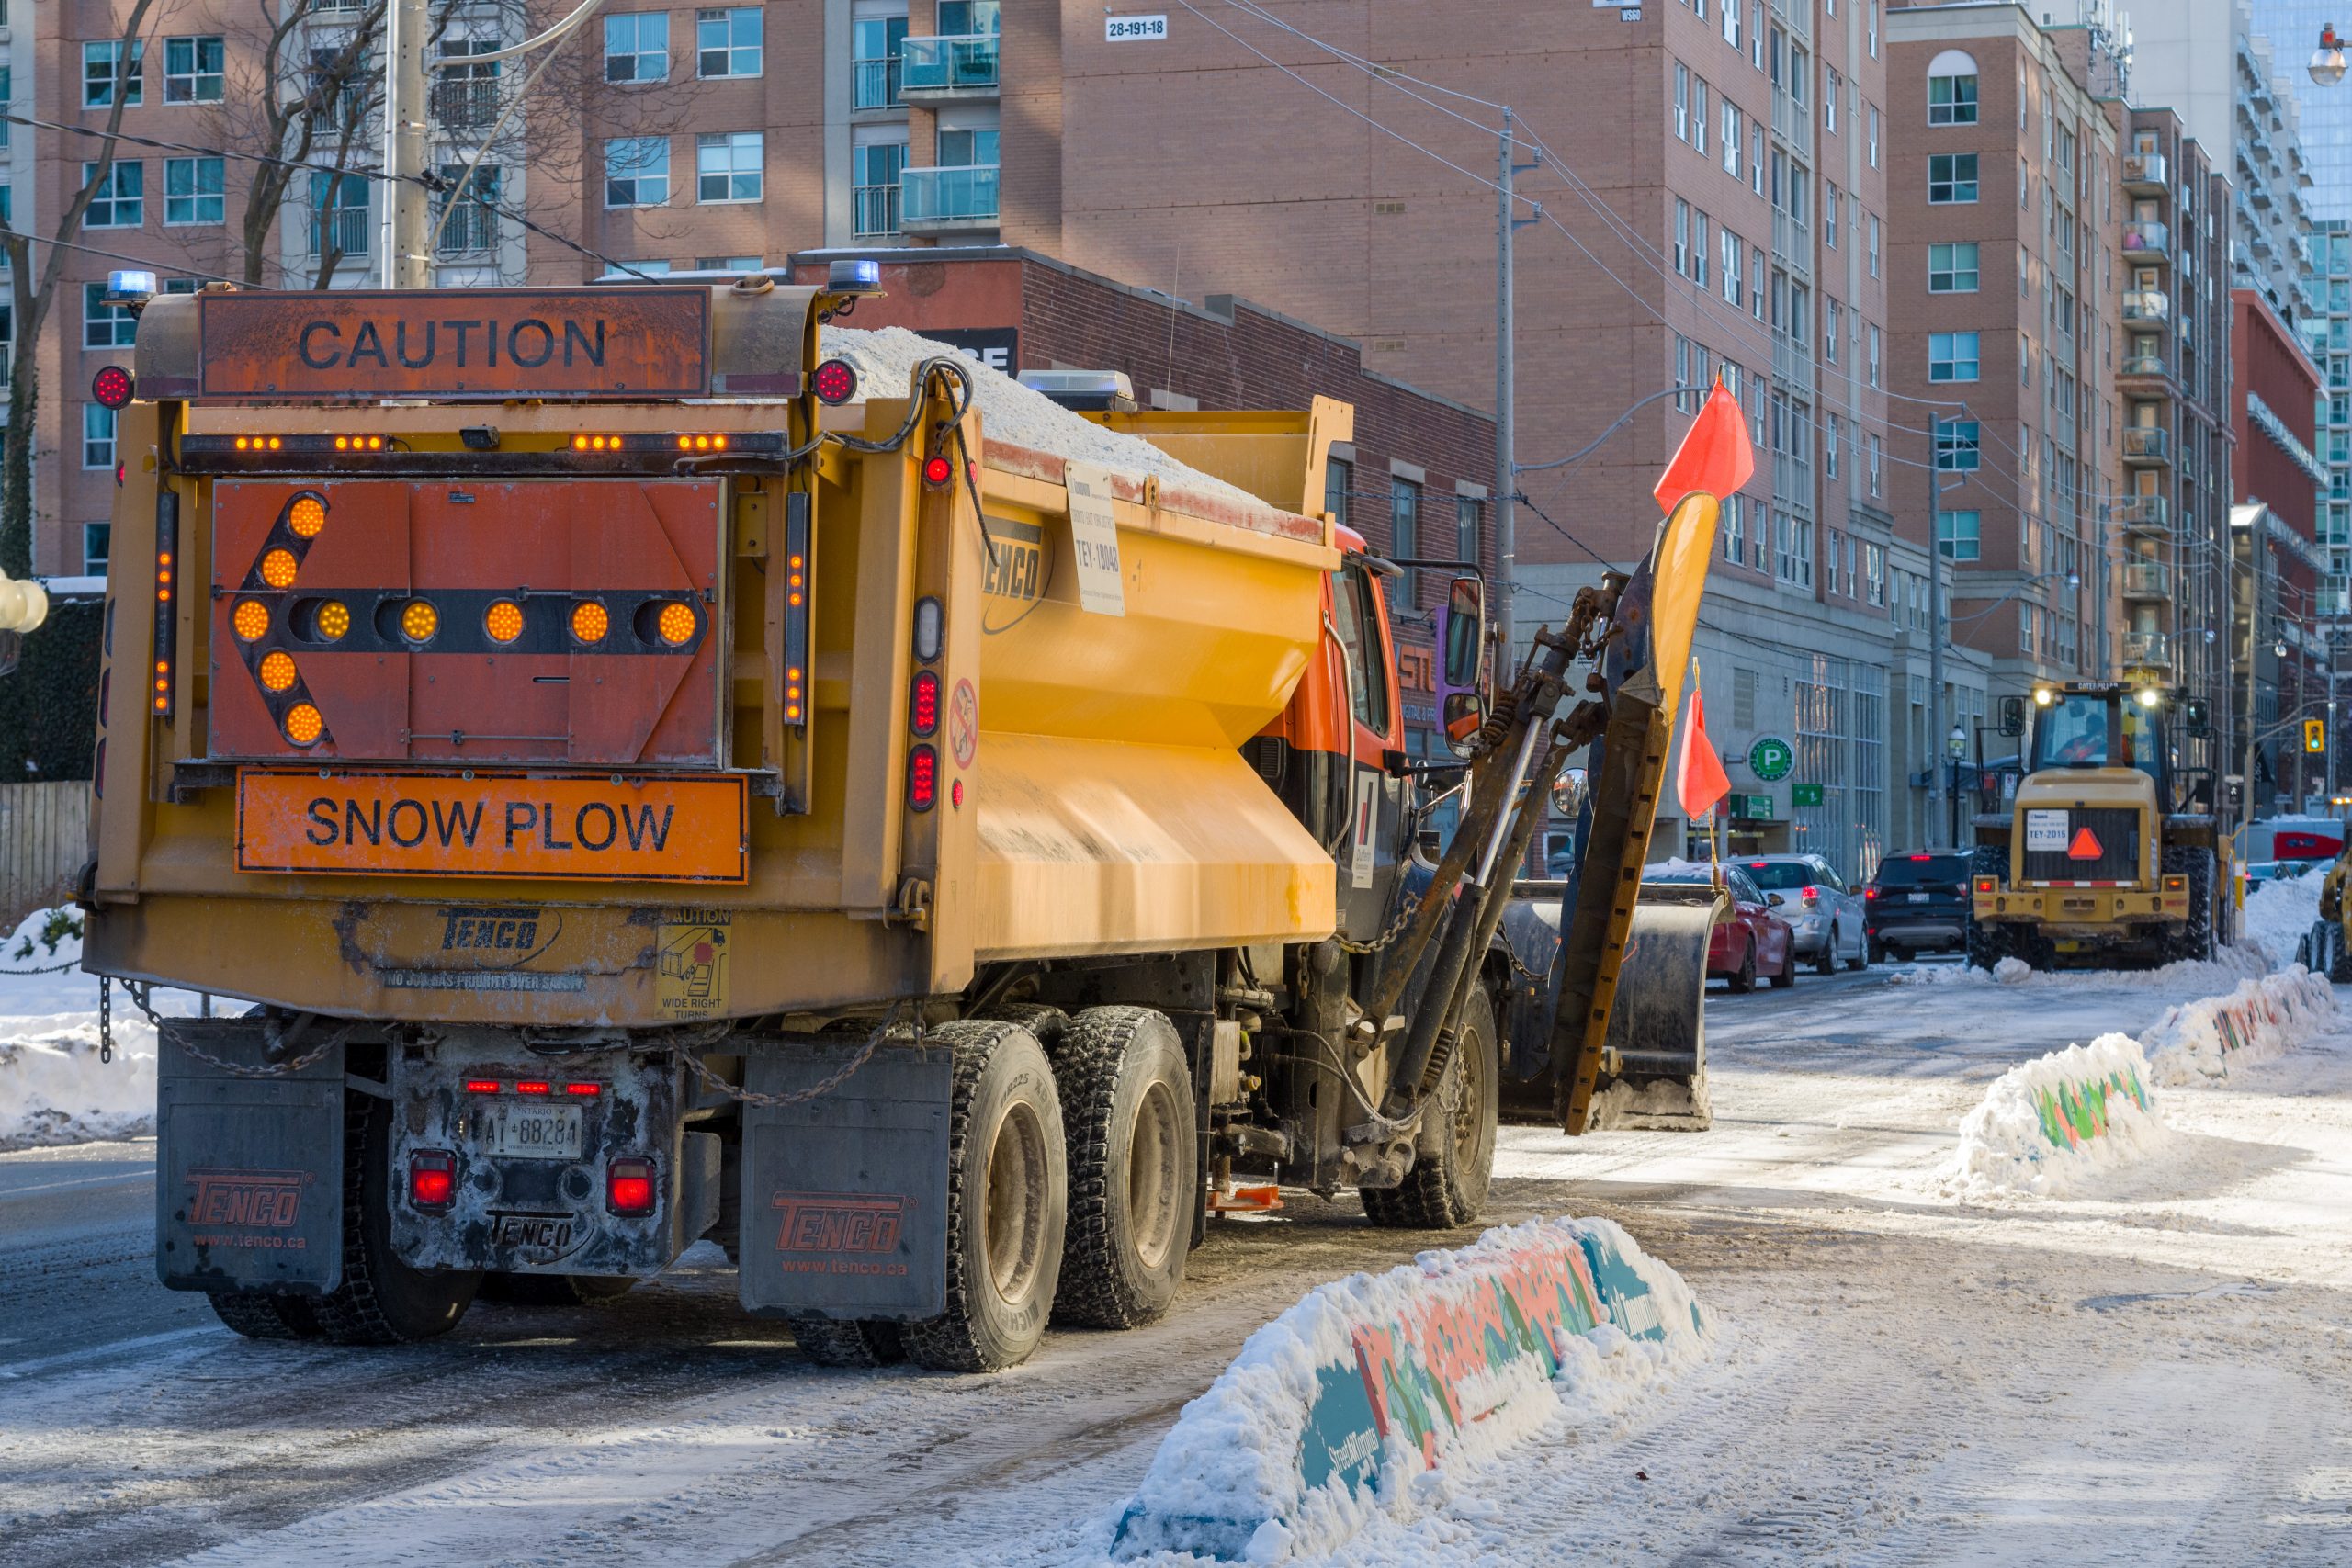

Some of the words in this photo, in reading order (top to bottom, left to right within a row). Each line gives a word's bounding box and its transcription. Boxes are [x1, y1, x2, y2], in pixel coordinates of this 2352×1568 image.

[1109, 20, 1163, 37] 28-191-18
[299, 319, 605, 368] CAUTION
[306, 797, 484, 848] SNOW
[504, 801, 674, 852] PLOW
[663, 908, 731, 925] AUTION
[436, 907, 540, 950] TENCO
[388, 973, 403, 986] NO
[662, 998, 688, 1008] WIDE
[691, 998, 721, 1009] RIGHT
[675, 1010, 708, 1021] TURNS
[185, 1168, 304, 1227] TENCO
[486, 1209, 574, 1247] TENCO
[772, 1191, 905, 1253] TENCO
[194, 1234, 306, 1248] www.tenco.ca
[783, 1259, 908, 1275] www.tenco.ca
